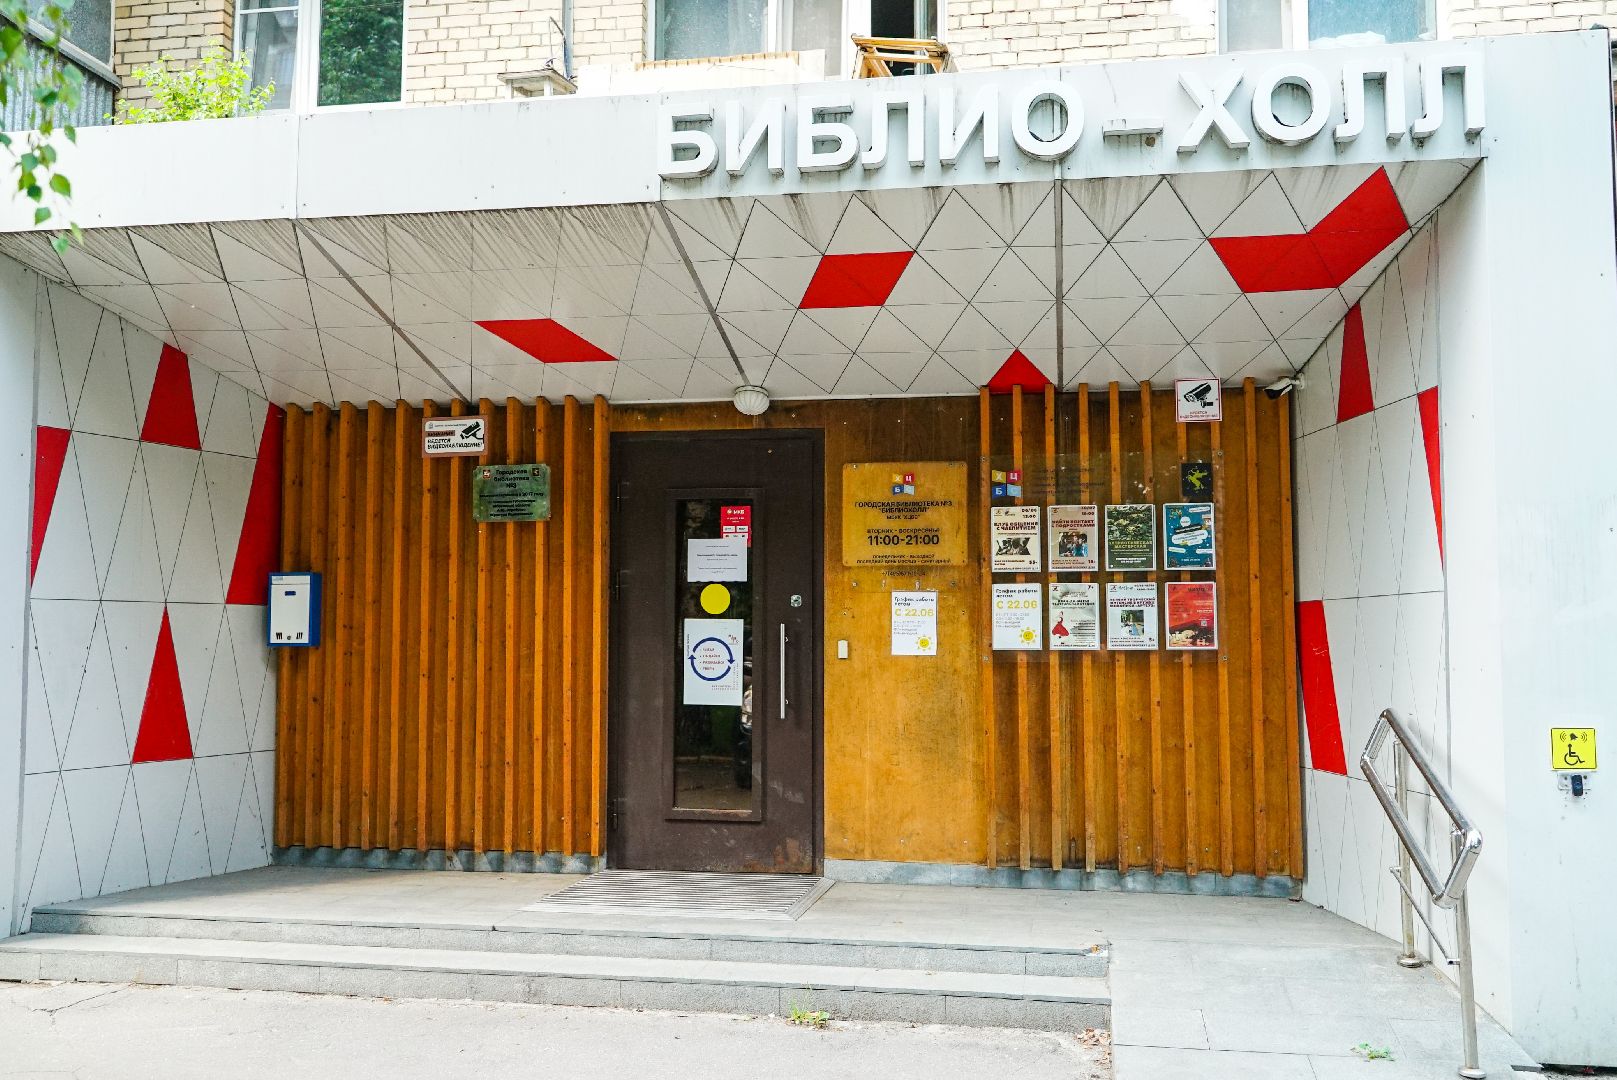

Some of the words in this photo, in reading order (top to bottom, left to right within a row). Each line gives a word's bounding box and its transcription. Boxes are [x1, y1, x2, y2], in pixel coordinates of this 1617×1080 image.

[657, 80, 1083, 180] БИБЛИО
[1176, 63, 1485, 155] ХОЛЛ
[1010, 473, 1017, 481] Ц
[996, 487, 1003, 495] Б
[867, 535, 940, 546] 11:00-21:00
[1007, 600, 1038, 609] 22.06
[904, 608, 934, 617] 22.06
